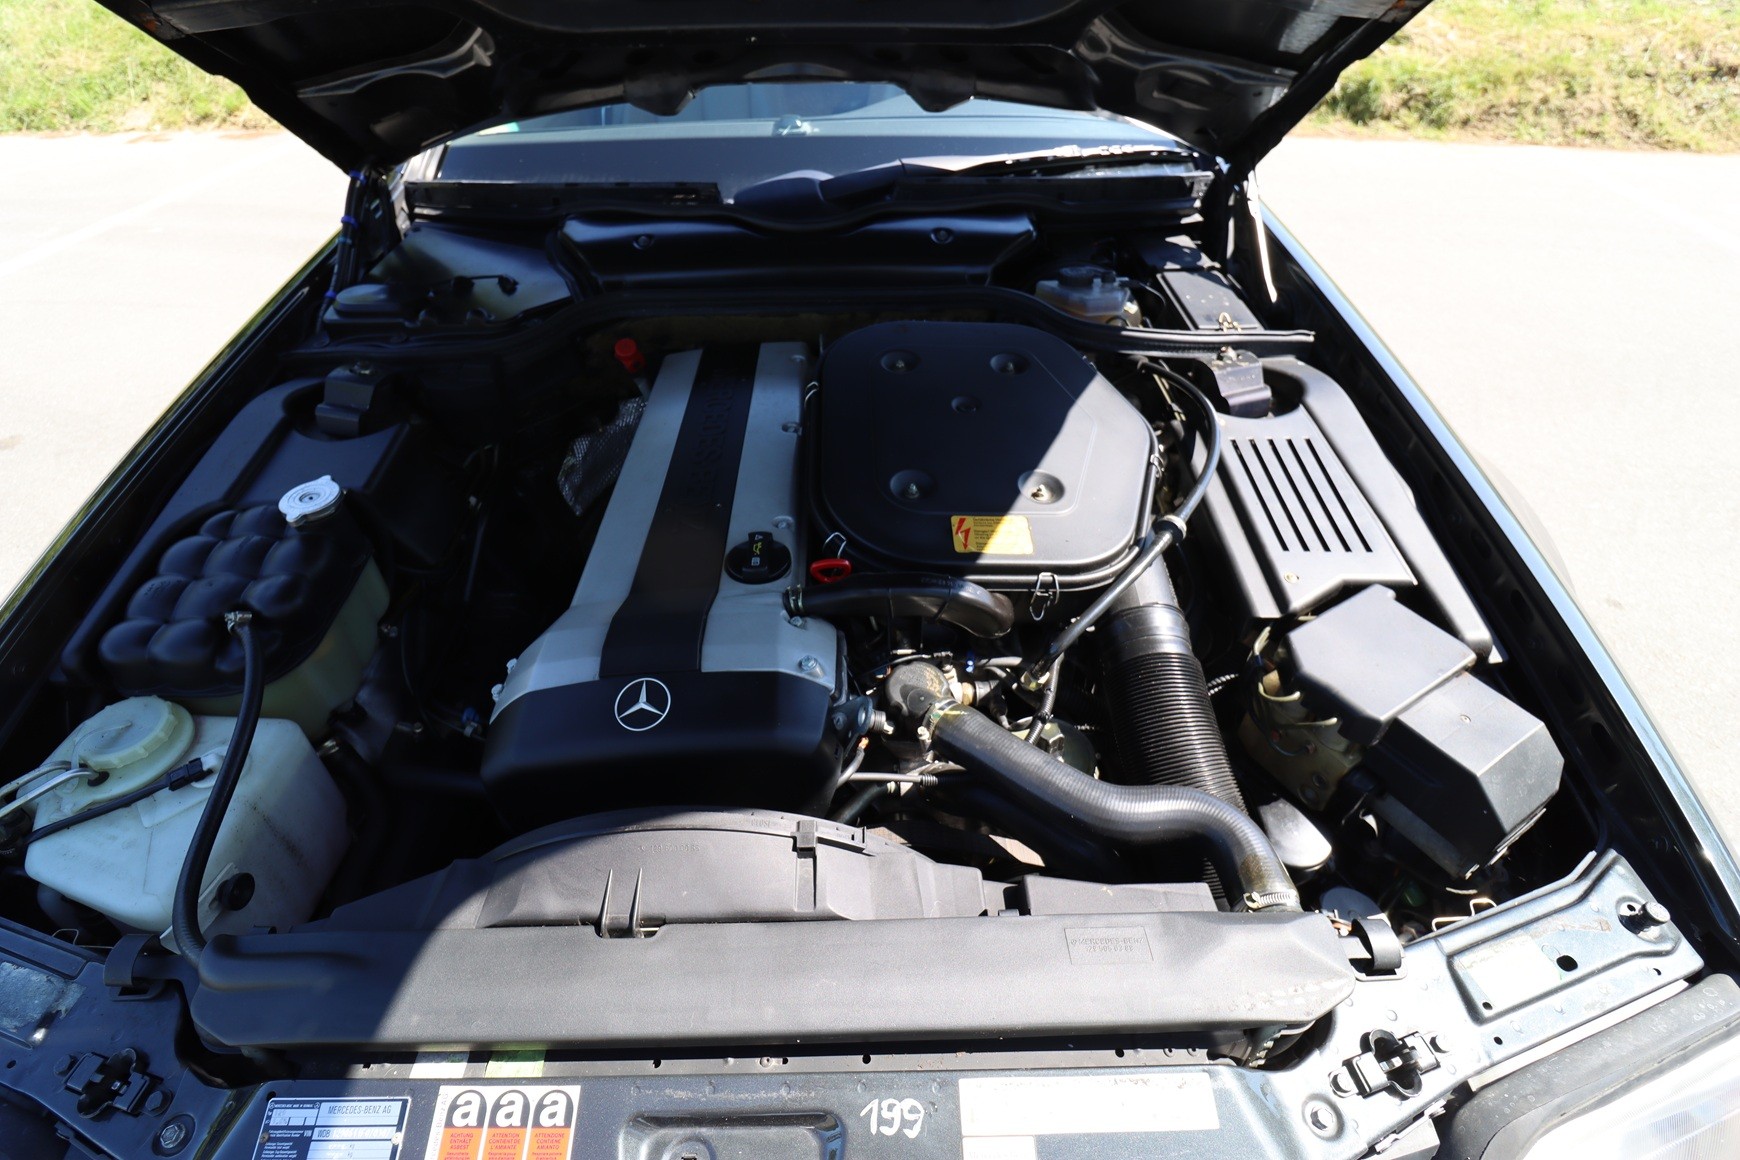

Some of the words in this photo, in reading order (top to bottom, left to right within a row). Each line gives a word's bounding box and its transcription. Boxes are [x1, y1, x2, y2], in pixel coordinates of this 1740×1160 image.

[328, 1105, 382, 1115] MERCEDES-BENZ
[382, 1105, 392, 1114] AG
[860, 1098, 925, 1138] 199
[317, 1129, 331, 1138] WDB
